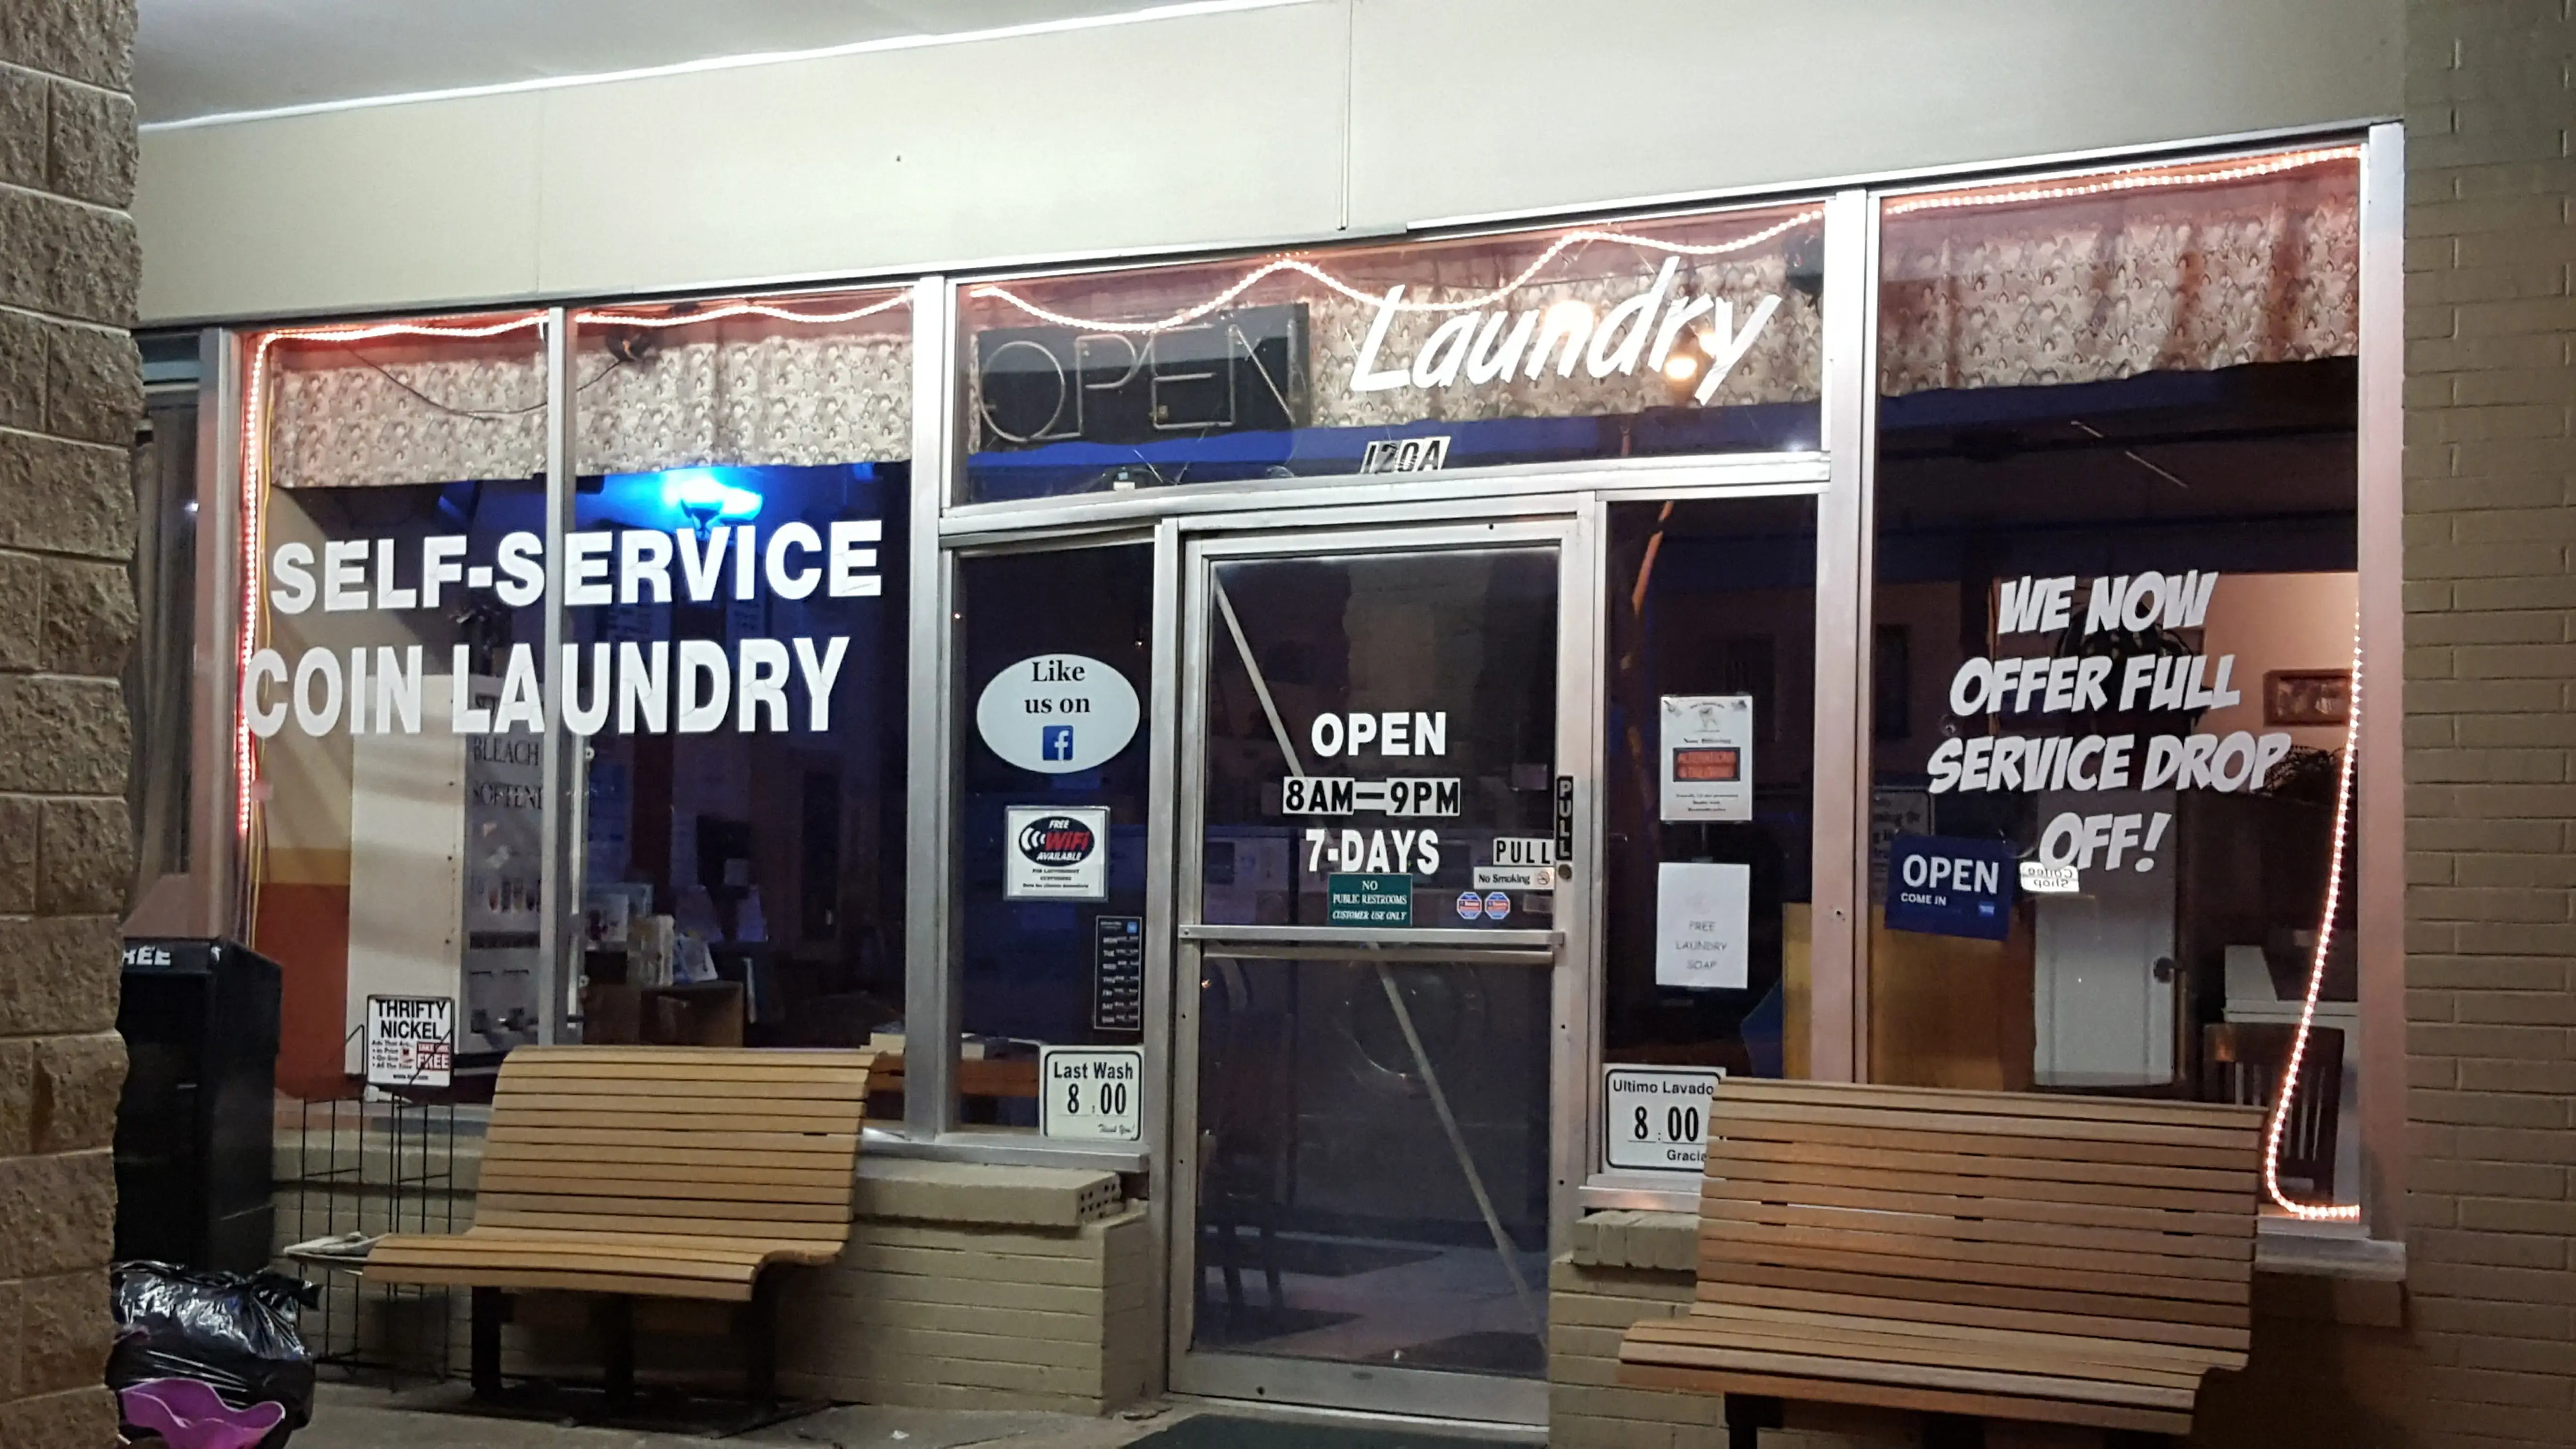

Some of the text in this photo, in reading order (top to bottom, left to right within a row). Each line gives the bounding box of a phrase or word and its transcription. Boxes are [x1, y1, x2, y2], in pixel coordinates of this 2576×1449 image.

[1350, 255, 1781, 404] Laundry
[979, 319, 1296, 442] OPEN
[272, 520, 882, 615] SELF-SERVICE
[1997, 569, 2220, 635] WE NOW
[1031, 660, 1086, 682] Like
[243, 637, 849, 738] COIN LAUNDRY
[1949, 654, 2241, 716] OFFER FULL
[1025, 697, 1090, 714] us on
[1311, 712, 1447, 757] OPEN
[473, 736, 539, 766] BLEACH
[1927, 731, 2291, 794] SERVICE DROP
[1049, 820, 1069, 829] FREE
[1559, 780, 1572, 857] PULL
[1306, 828, 1440, 875] 7-DAYS
[2039, 811, 2172, 872] OFF!
[1036, 852, 1082, 861] AVAILABLE
[1496, 840, 1551, 864] PULL
[1479, 873, 1531, 885] No Smoking
[1902, 854, 1999, 895] OPEN
[1362, 880, 1379, 891] NO
[1333, 893, 1407, 905] PUBLIC RESTROOMS
[1900, 892, 1947, 906] COME IN
[1332, 910, 1407, 920] CUSTOMER USE ONLY
[1689, 920, 1716, 932] FREE
[1675, 941, 1727, 951] LAUNDRY
[1686, 960, 1717, 970] SOAP
[375, 999, 446, 1019] THRIFTY
[381, 1020, 442, 1040] NICKEL
[418, 1053, 449, 1070] FREE
[1054, 1062, 1133, 1080] Last Wash
[1613, 1079, 1714, 1095] Ultimo Lavado
